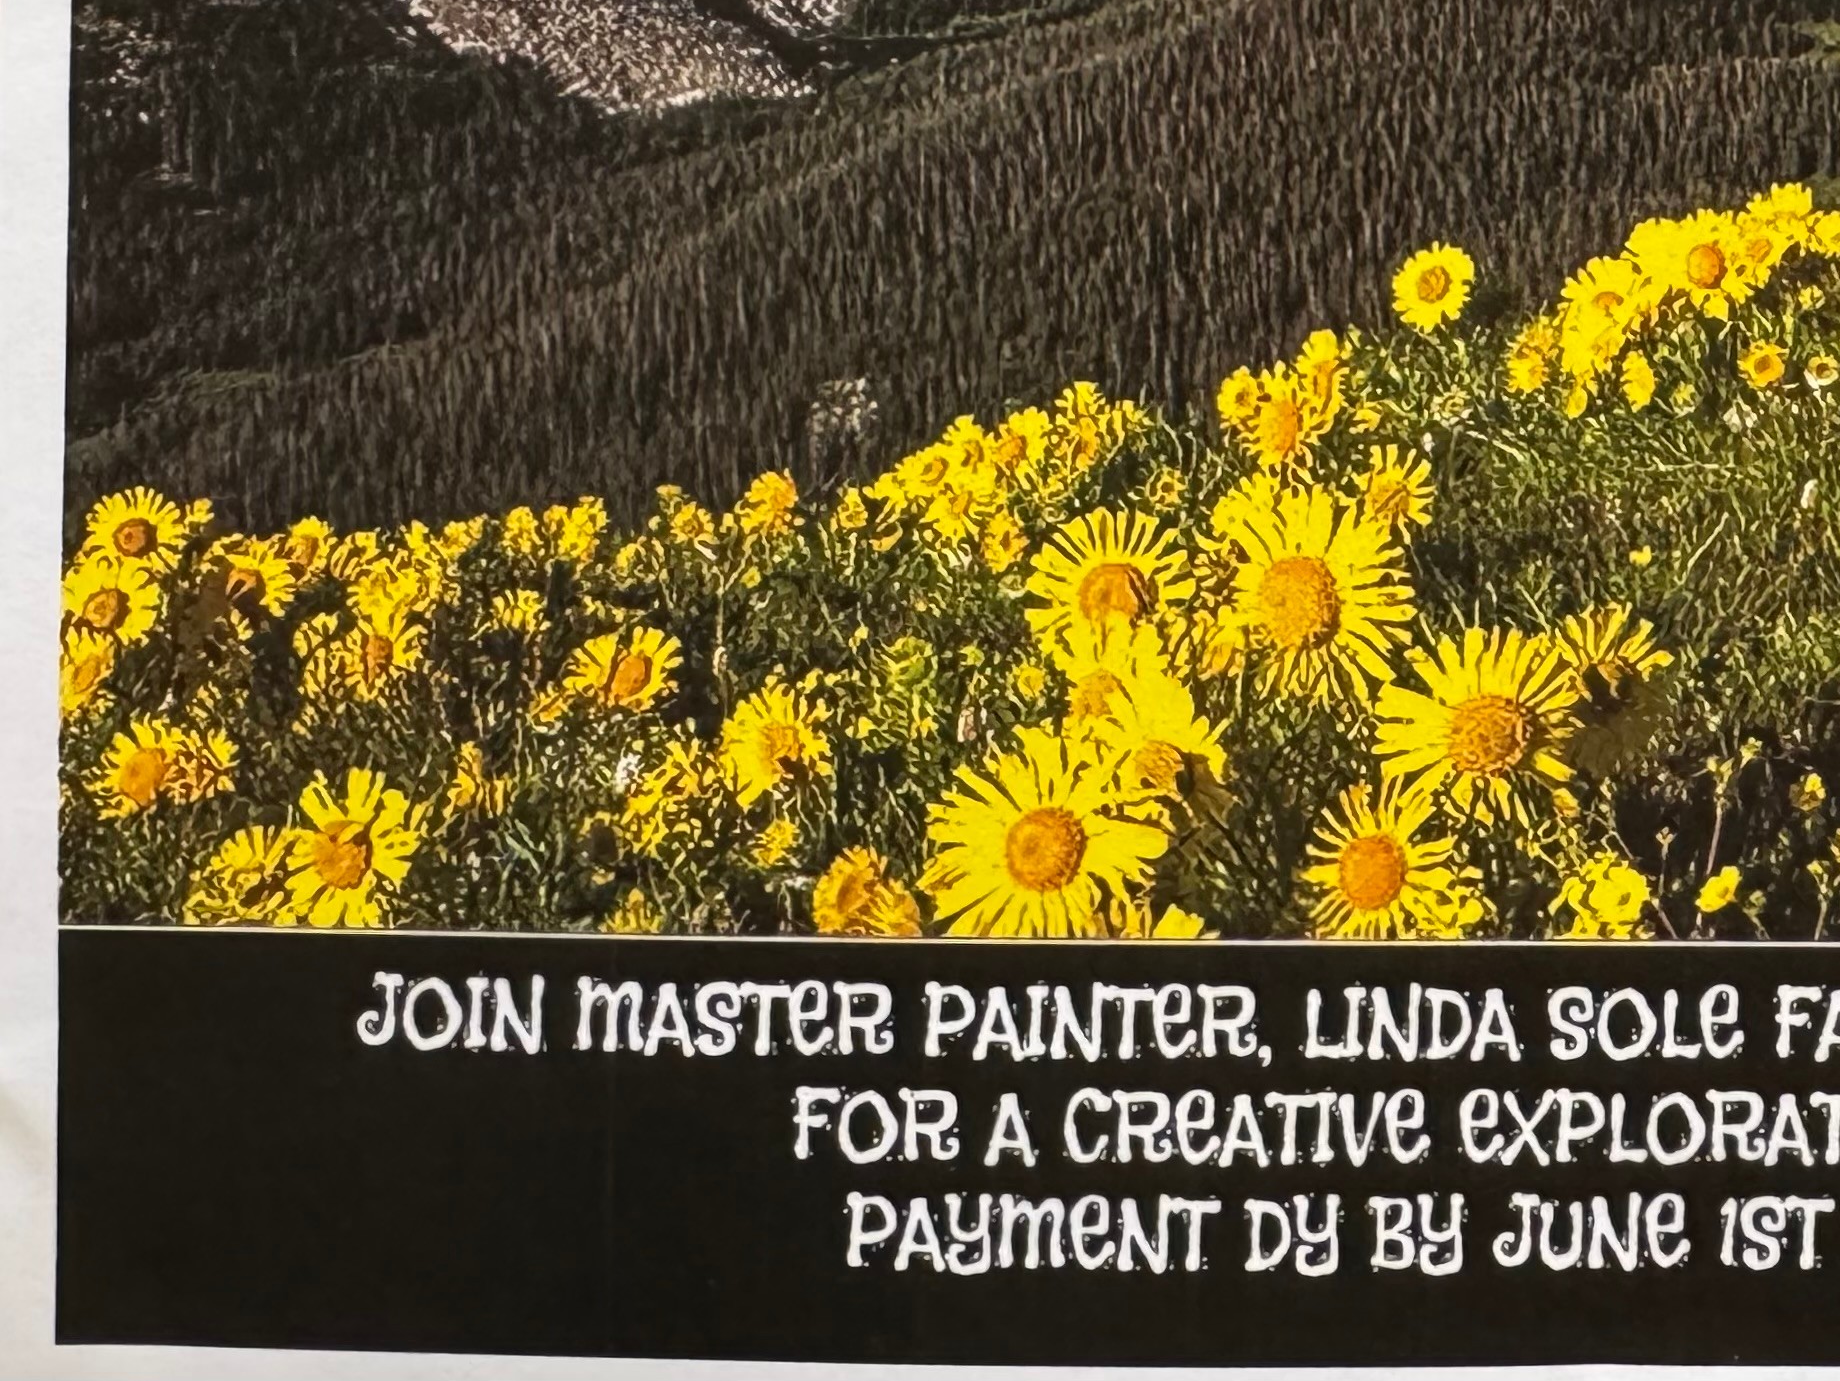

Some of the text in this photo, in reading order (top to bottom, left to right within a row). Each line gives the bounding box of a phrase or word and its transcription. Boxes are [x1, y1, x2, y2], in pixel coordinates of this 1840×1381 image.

[357, 972, 544, 1054] JOIN
[1305, 983, 1520, 1062] LINDA
[793, 1086, 959, 1163] FOR
[985, 1093, 1035, 1166] A
[1244, 1194, 1339, 1276] DY
[1369, 1193, 1464, 1276] BY
[1720, 1196, 1835, 1270] 1ST
